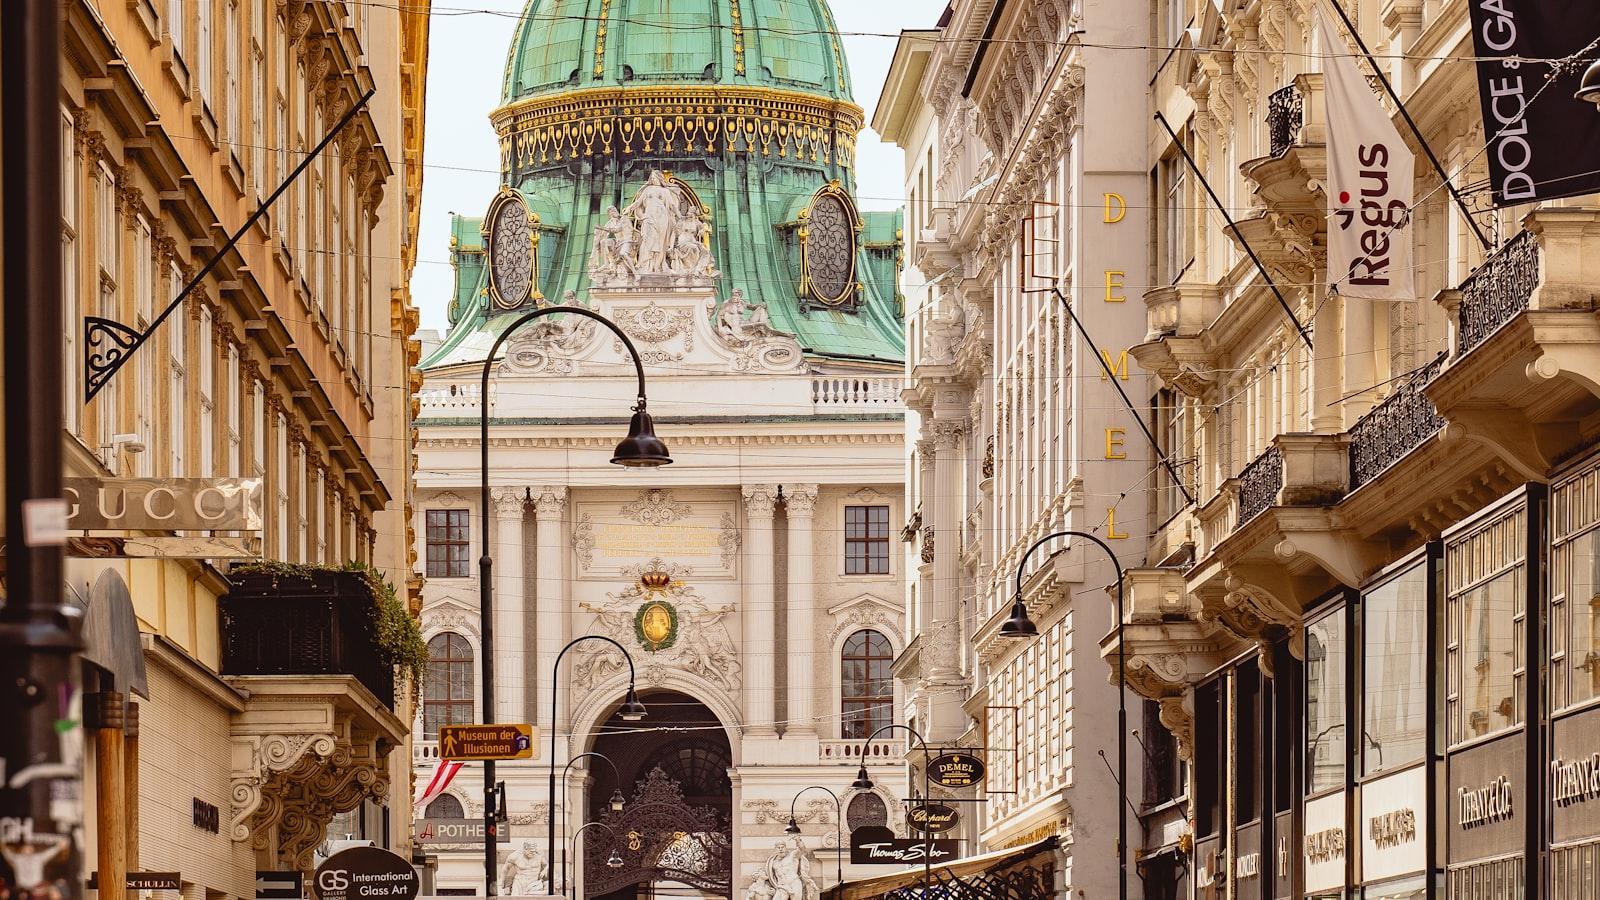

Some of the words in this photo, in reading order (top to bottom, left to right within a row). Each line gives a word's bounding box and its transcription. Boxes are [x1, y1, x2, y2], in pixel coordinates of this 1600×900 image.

[1502, 54, 1520, 69] &
[1489, 75, 1537, 200] DOLCE
[1349, 143, 1411, 286] Regus
[1101, 192, 1129, 539] DEMEL
[458, 730, 497, 741] Museum
[500, 729, 516, 740] der
[464, 742, 511, 754] Illusionen
[939, 763, 974, 773] DEMEL
[911, 809, 955, 823] Chpard
[420, 822, 505, 840] APOTHEE
[859, 843, 905, 860] Thomas
[126, 880, 177, 888] SCHULLIN
[319, 869, 348, 890] GS
[352, 871, 413, 882] International
[359, 885, 389, 896] Glass
[392, 884, 408, 895] Art
